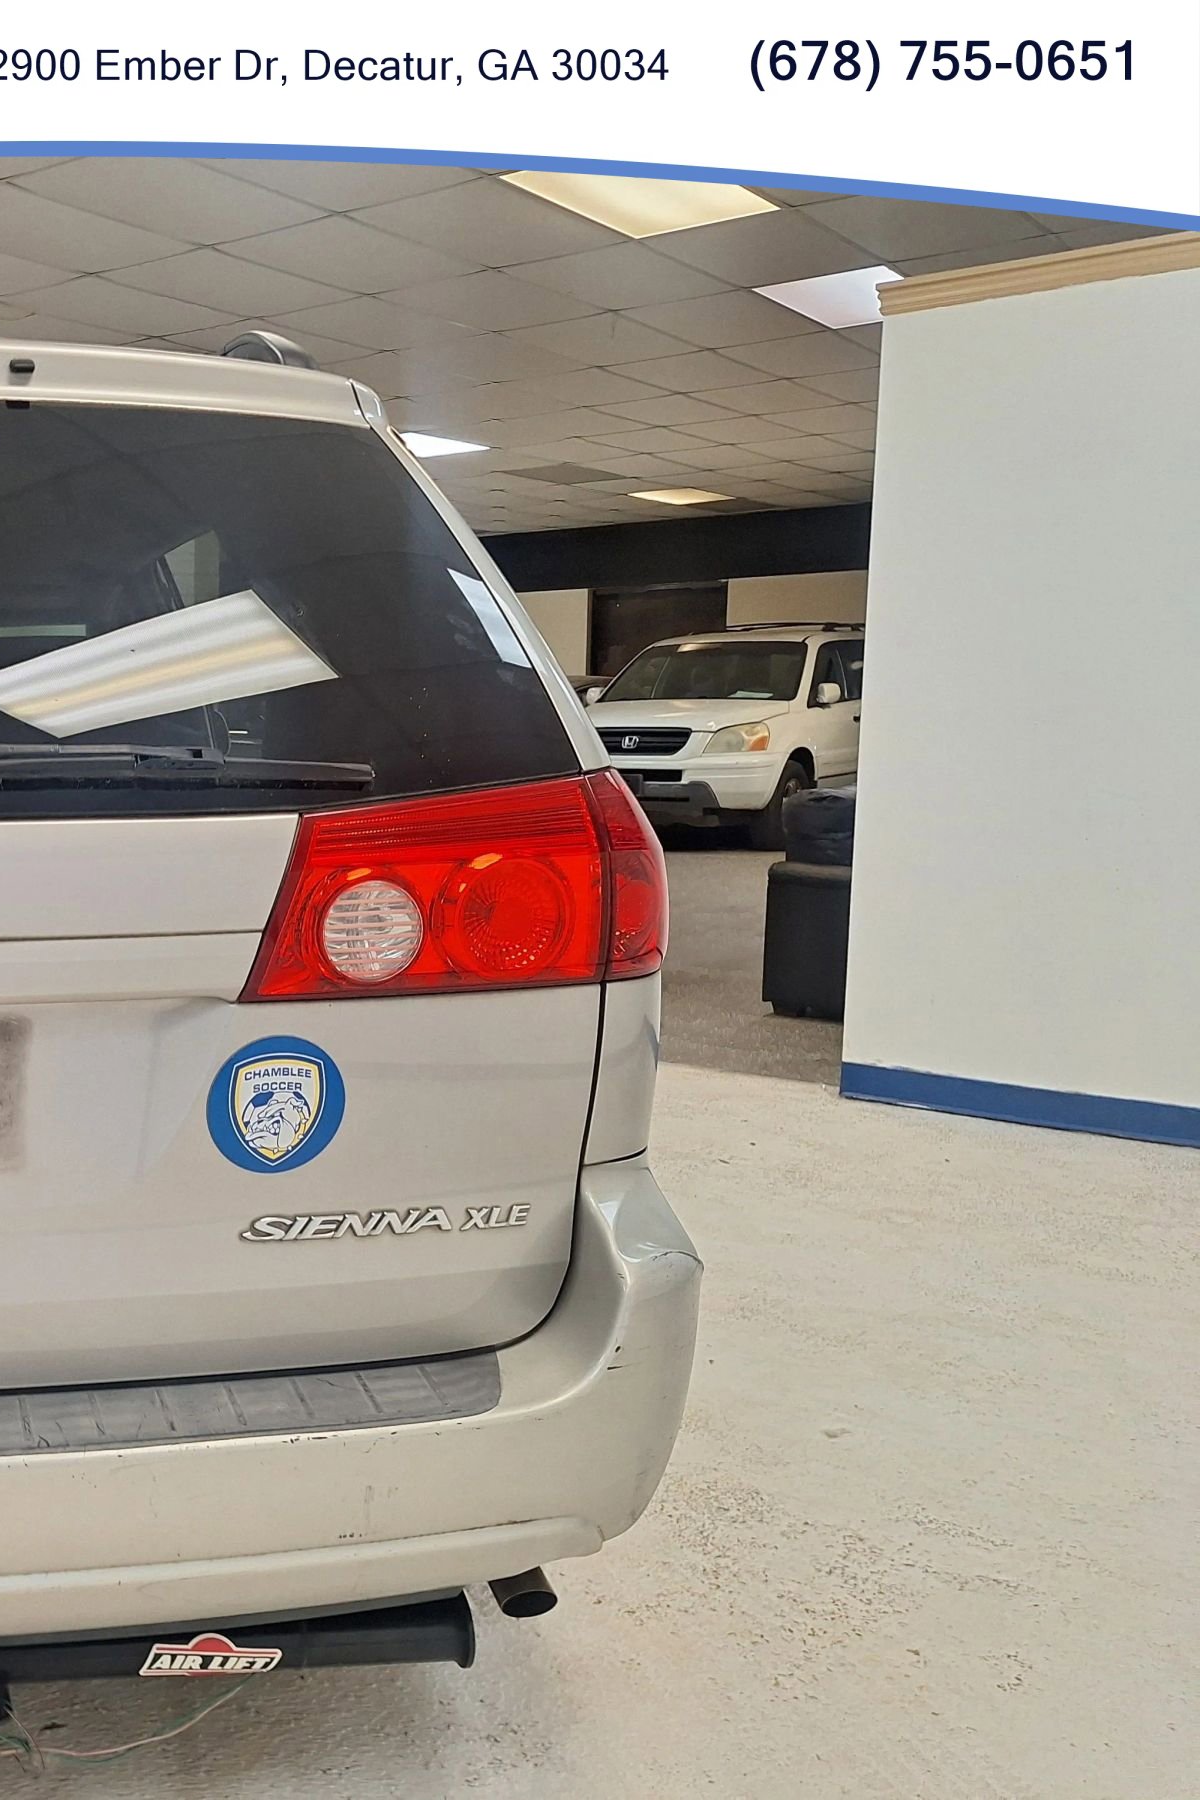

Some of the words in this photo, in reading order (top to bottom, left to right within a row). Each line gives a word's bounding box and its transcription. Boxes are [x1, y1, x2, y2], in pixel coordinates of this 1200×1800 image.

[244, 1066, 313, 1082] CHAMBLEE
[252, 1081, 304, 1094] SOCCER
[240, 1206, 453, 1242] SIENNA
[458, 1202, 531, 1232] XLE
[151, 1654, 203, 1670] AIR
[206, 1655, 272, 1671] LIFT
